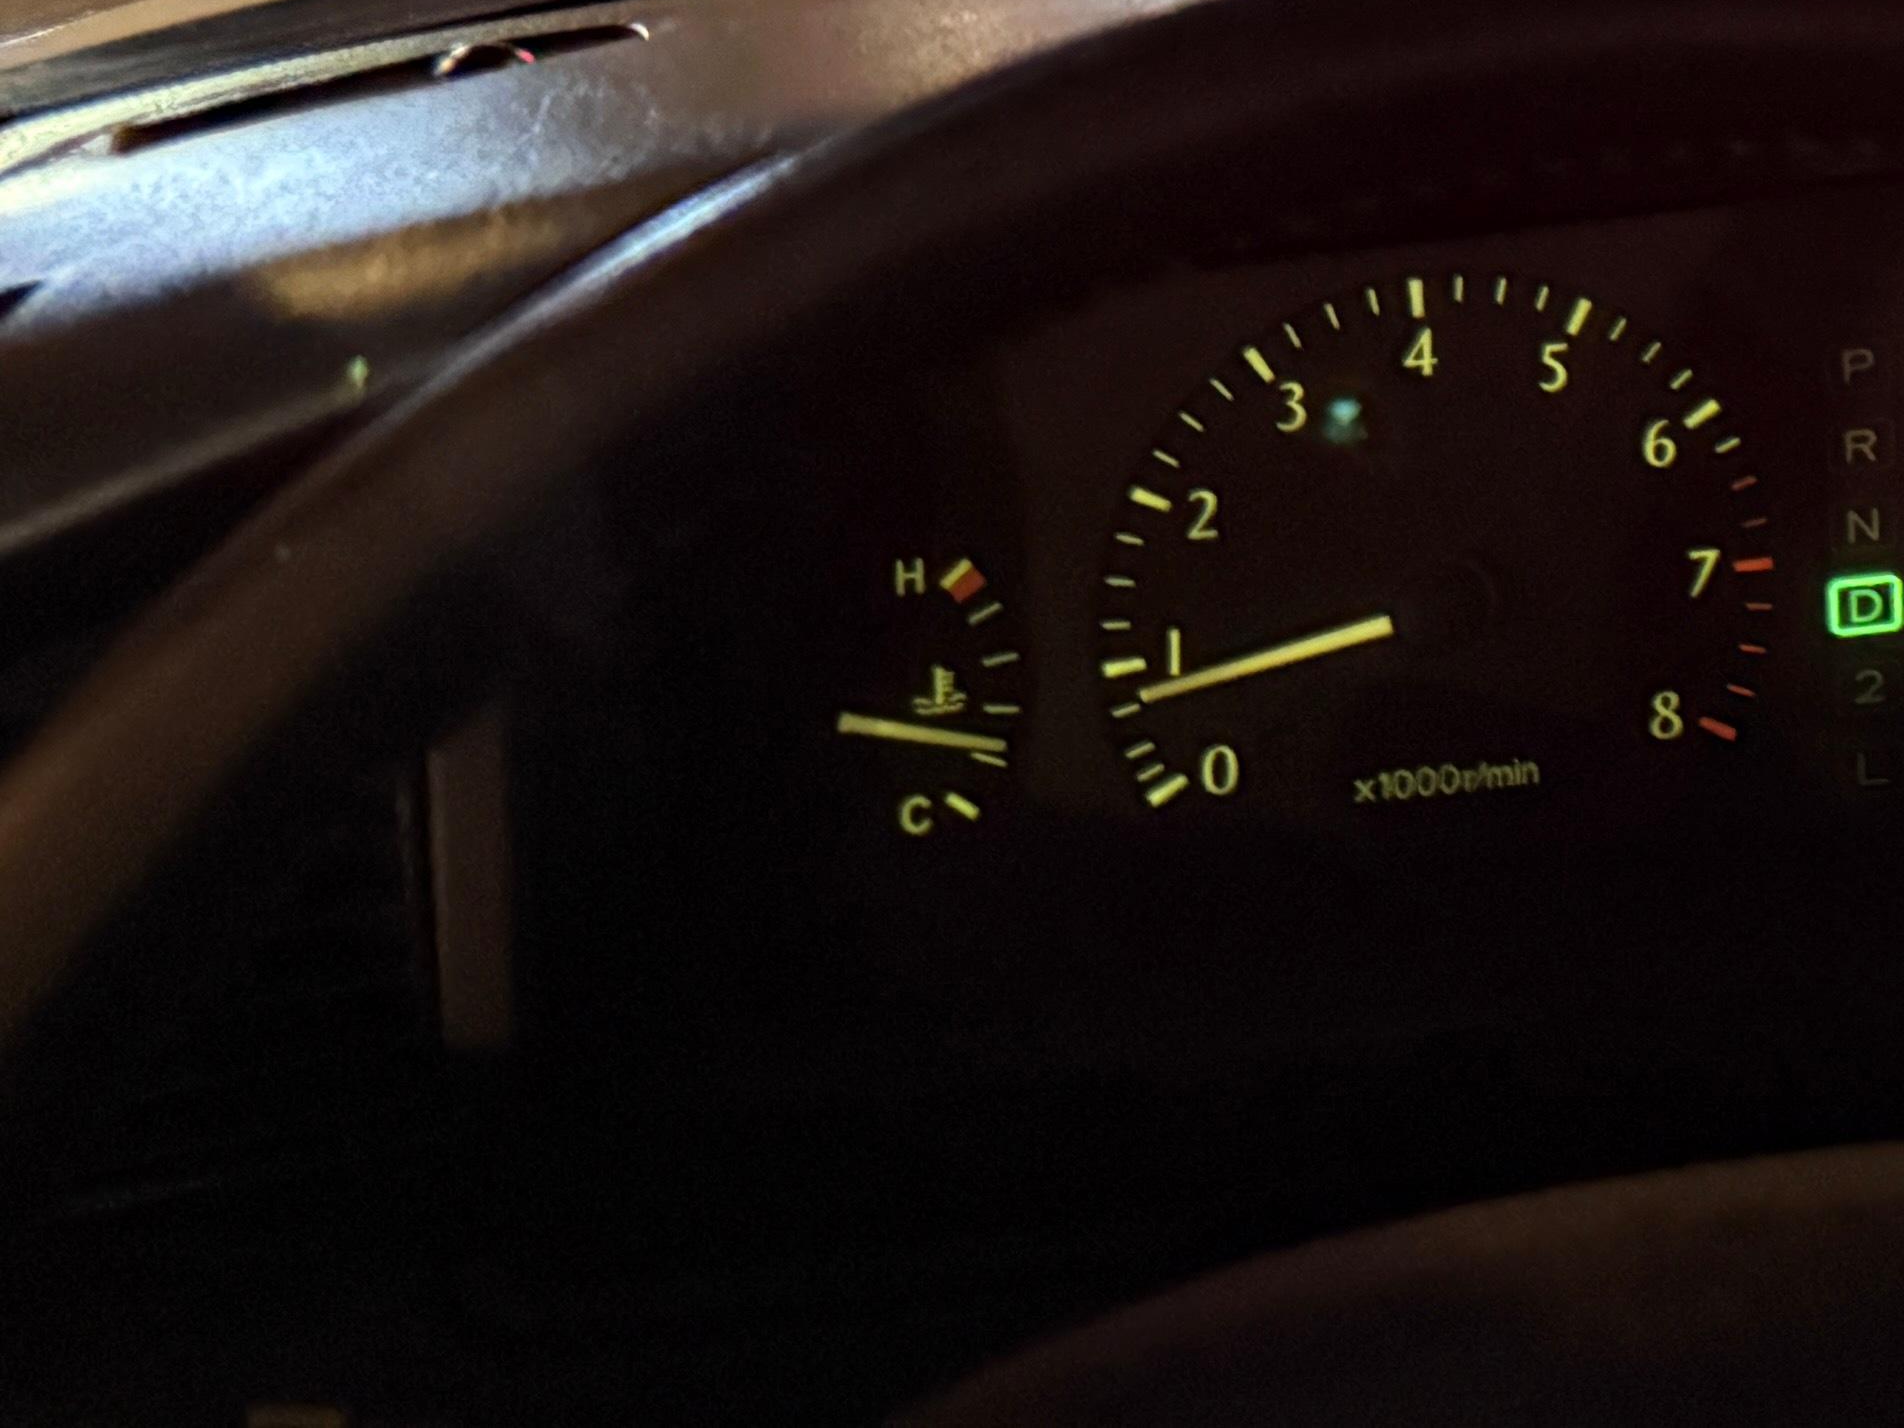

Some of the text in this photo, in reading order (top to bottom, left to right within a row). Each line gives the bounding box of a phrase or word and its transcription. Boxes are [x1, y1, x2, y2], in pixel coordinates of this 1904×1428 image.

[1403, 329, 1437, 375] 4
[1541, 343, 1567, 392] 5
[1842, 348, 1874, 381] P
[1278, 382, 1306, 431] 3
[1644, 420, 1676, 467] 6
[1845, 429, 1877, 461] R
[1189, 490, 1217, 539] 2
[1847, 508, 1879, 542] N
[896, 558, 925, 595] H
[1690, 549, 1719, 596] 7
[1849, 592, 1880, 622] D
[1166, 630, 1180, 680] 1
[1855, 669, 1884, 703] 2
[1651, 692, 1682, 739] 8
[1202, 746, 1238, 794] 0
[1354, 759, 1539, 802] x1000r/min
[901, 796, 930, 834] C
